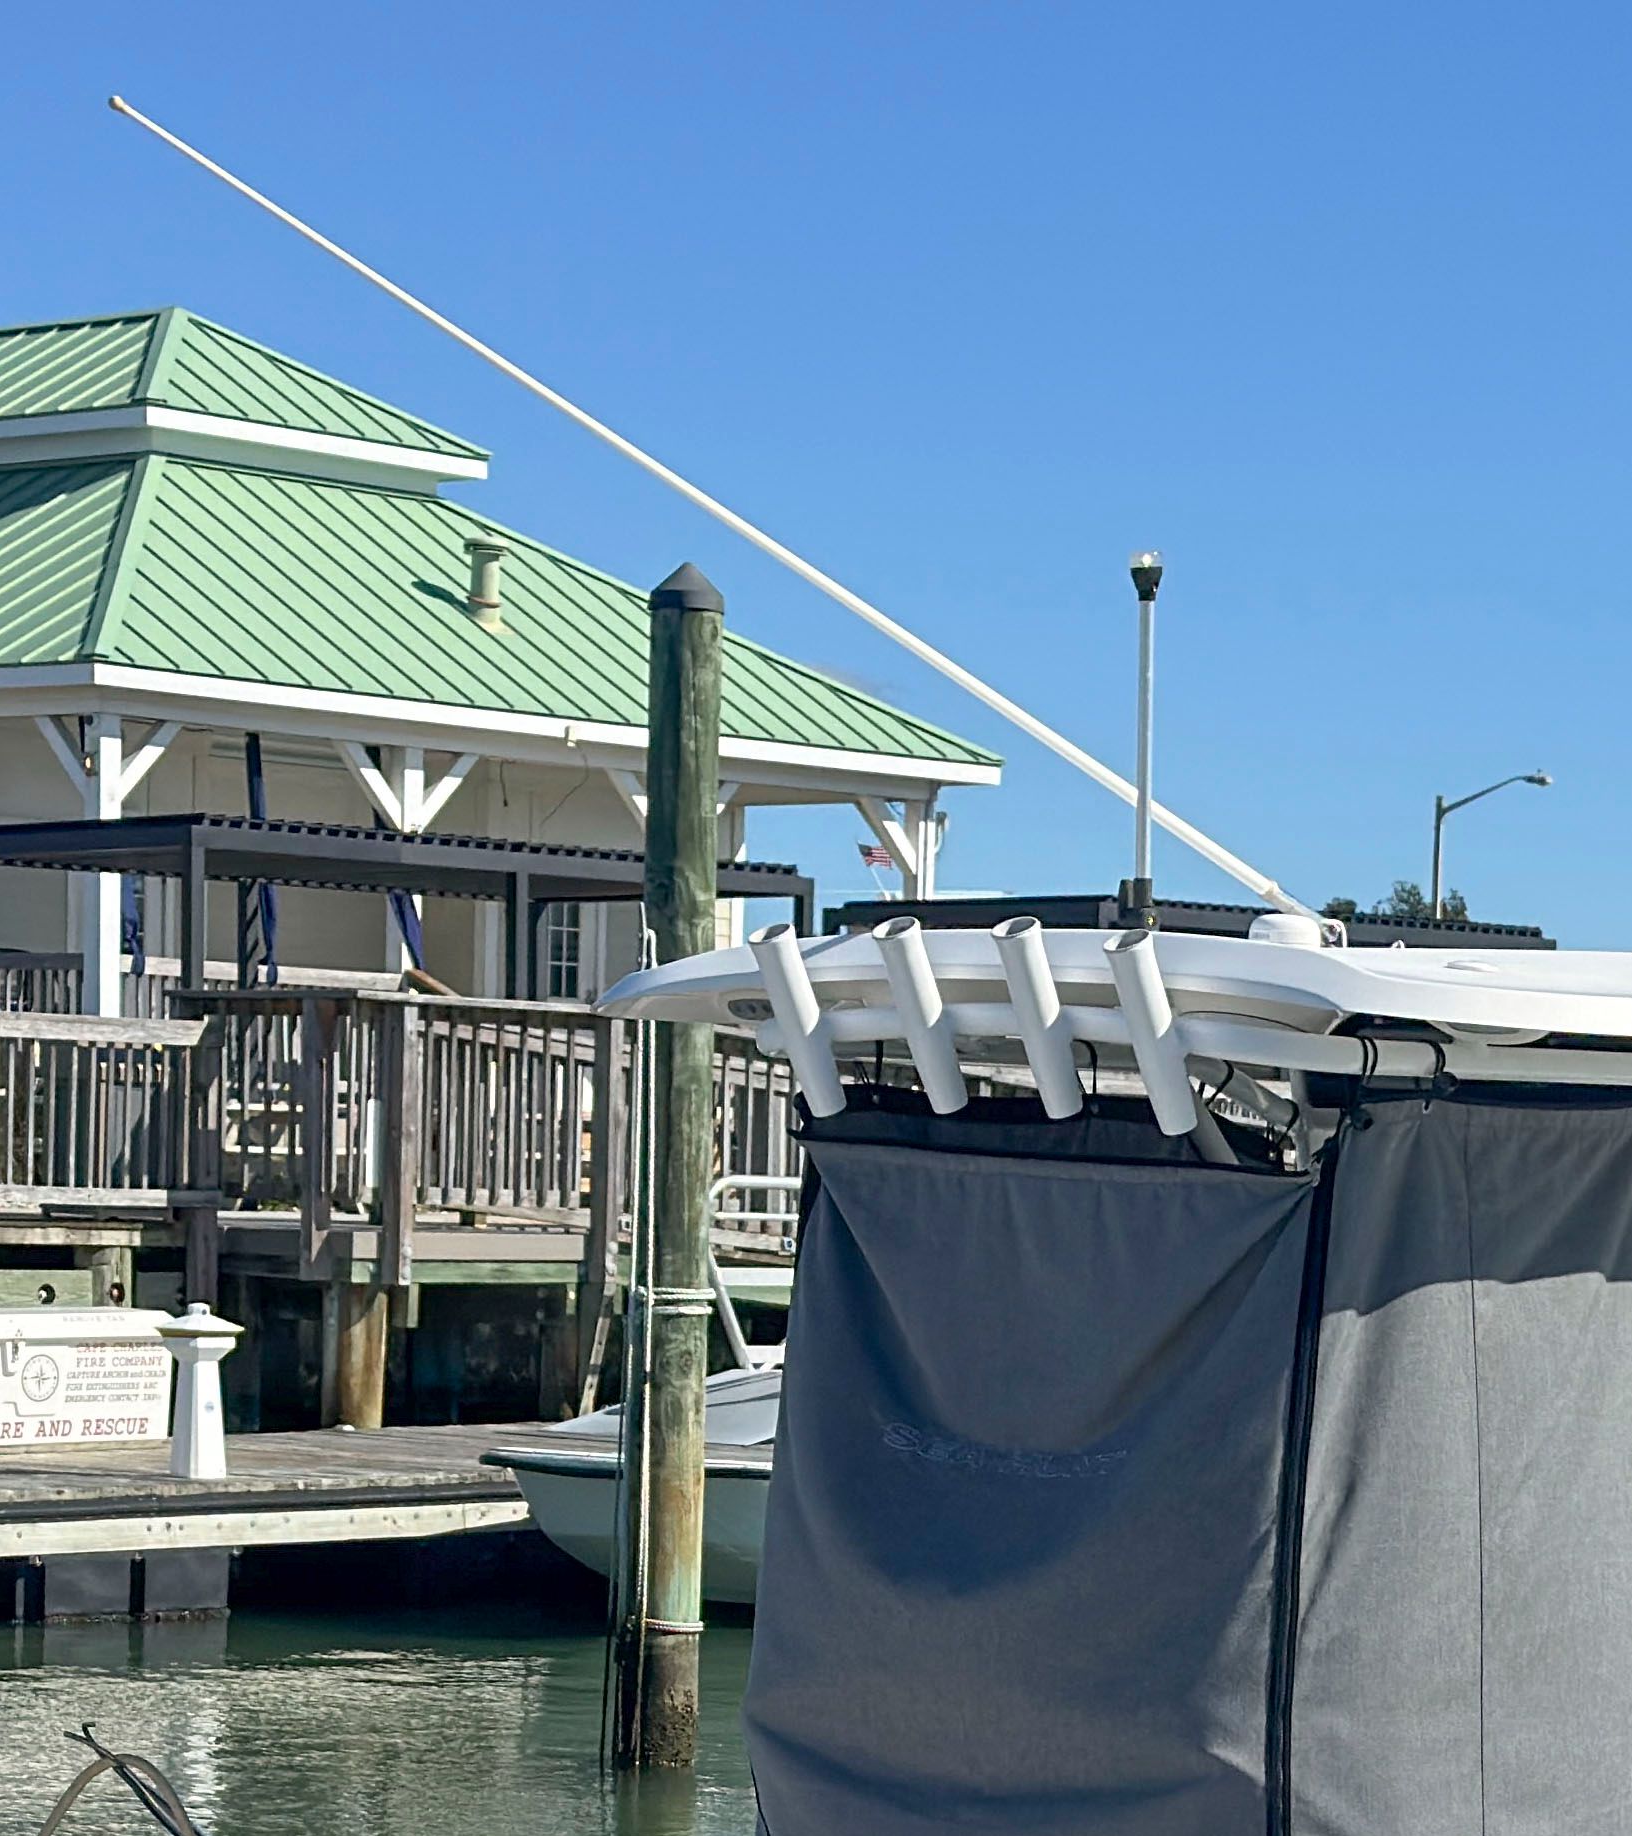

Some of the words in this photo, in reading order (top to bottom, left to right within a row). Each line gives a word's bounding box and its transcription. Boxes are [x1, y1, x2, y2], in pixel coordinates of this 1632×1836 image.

[76, 1342, 108, 1353] CAPE
[111, 1341, 163, 1352] CHARLES
[76, 1357, 107, 1368] FIRE
[111, 1356, 164, 1367] COMPANY
[34, 1419, 73, 1438] AND
[80, 1417, 150, 1436] RESCUE
